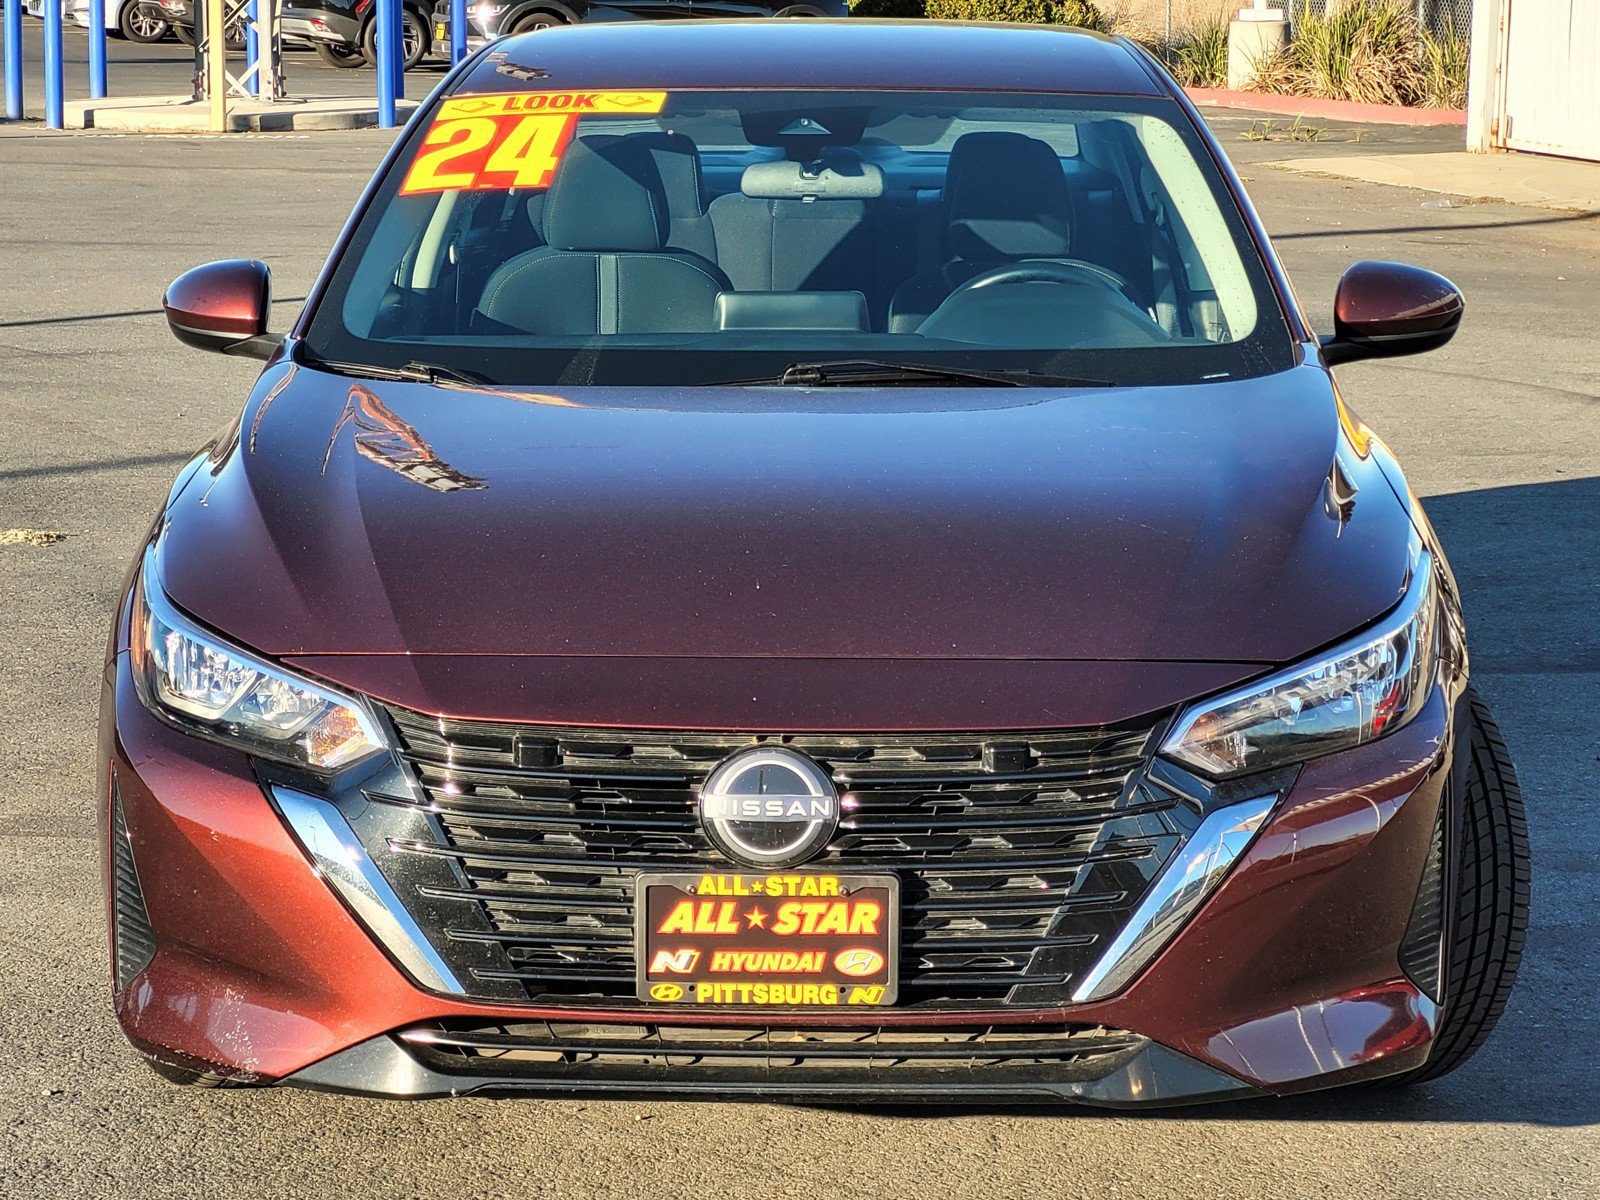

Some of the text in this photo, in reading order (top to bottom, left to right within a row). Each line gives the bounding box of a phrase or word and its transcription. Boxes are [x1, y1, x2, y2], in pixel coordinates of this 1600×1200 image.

[502, 94, 597, 112] LOOK
[404, 115, 568, 192] 24
[706, 799, 830, 817] NISSAN
[697, 875, 839, 897] ALL STAR
[657, 901, 881, 936] ALL STAR
[709, 950, 827, 972] HYUNDAI
[697, 983, 838, 1005] PITTSBURG
